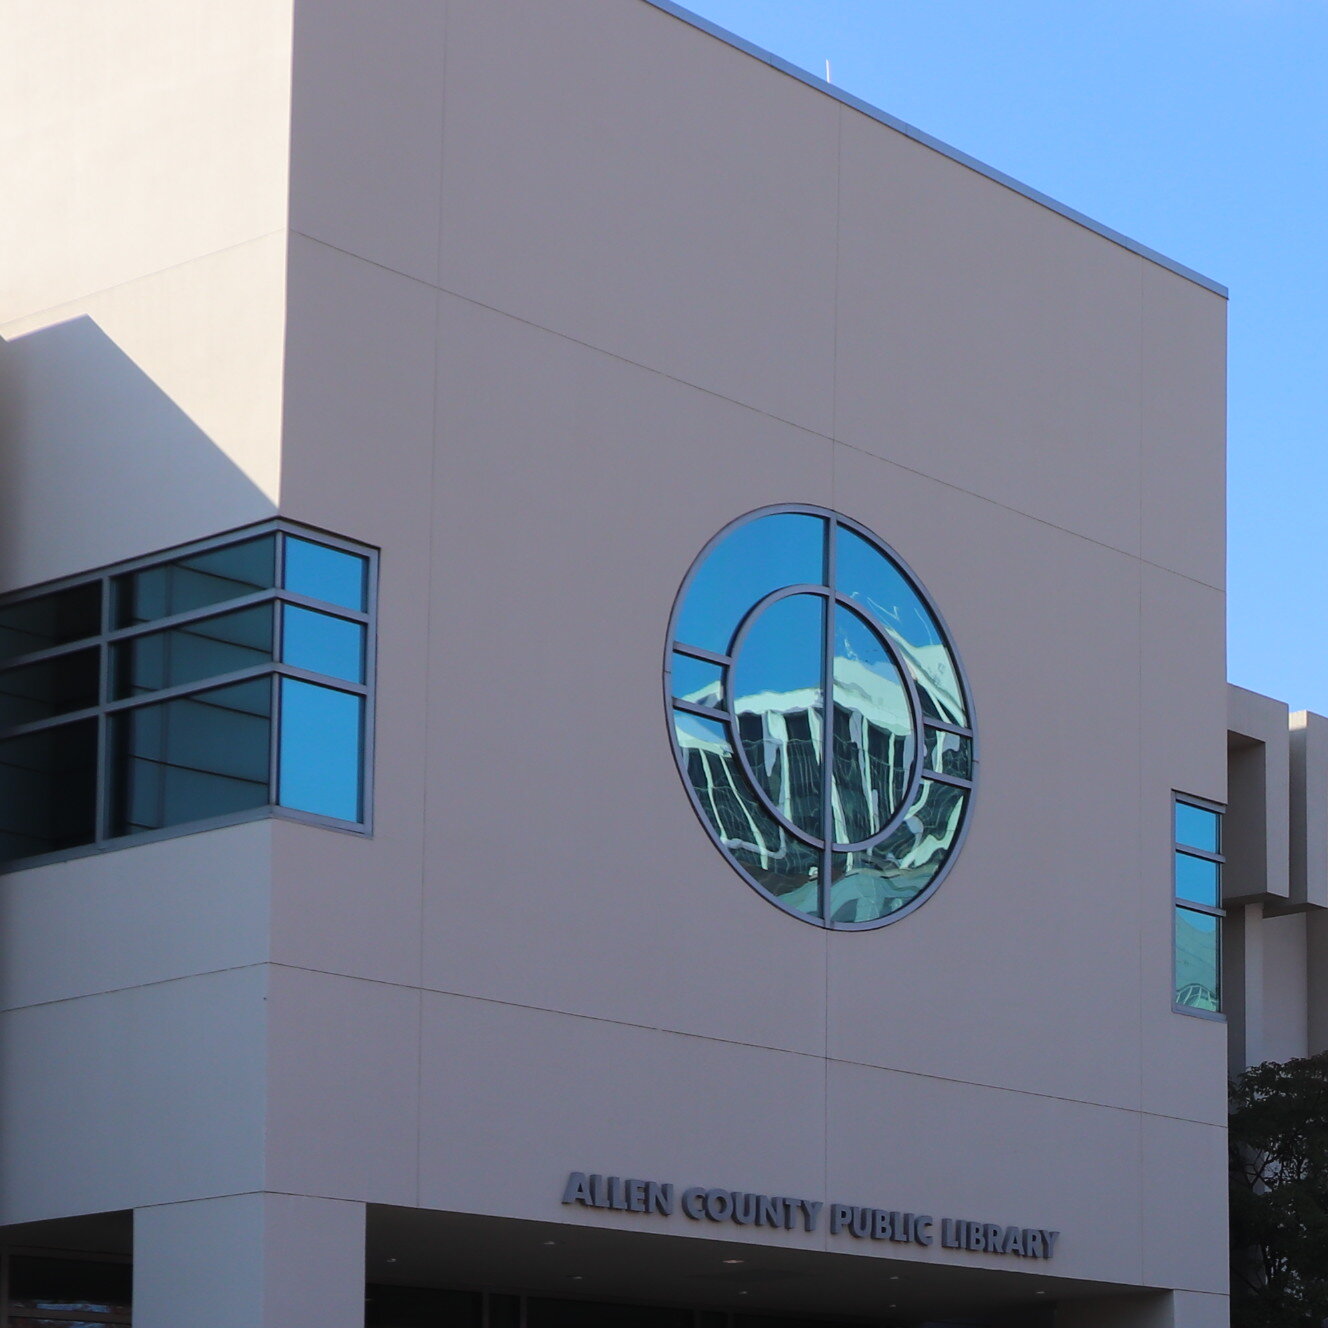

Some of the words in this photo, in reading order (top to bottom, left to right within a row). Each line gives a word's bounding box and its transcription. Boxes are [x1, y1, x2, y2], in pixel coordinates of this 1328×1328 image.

[562, 1171, 674, 1216] ALLEN
[681, 1186, 823, 1232] COUNTY
[830, 1203, 934, 1247] PUBLIC
[941, 1217, 1060, 1259] LIBRARY
